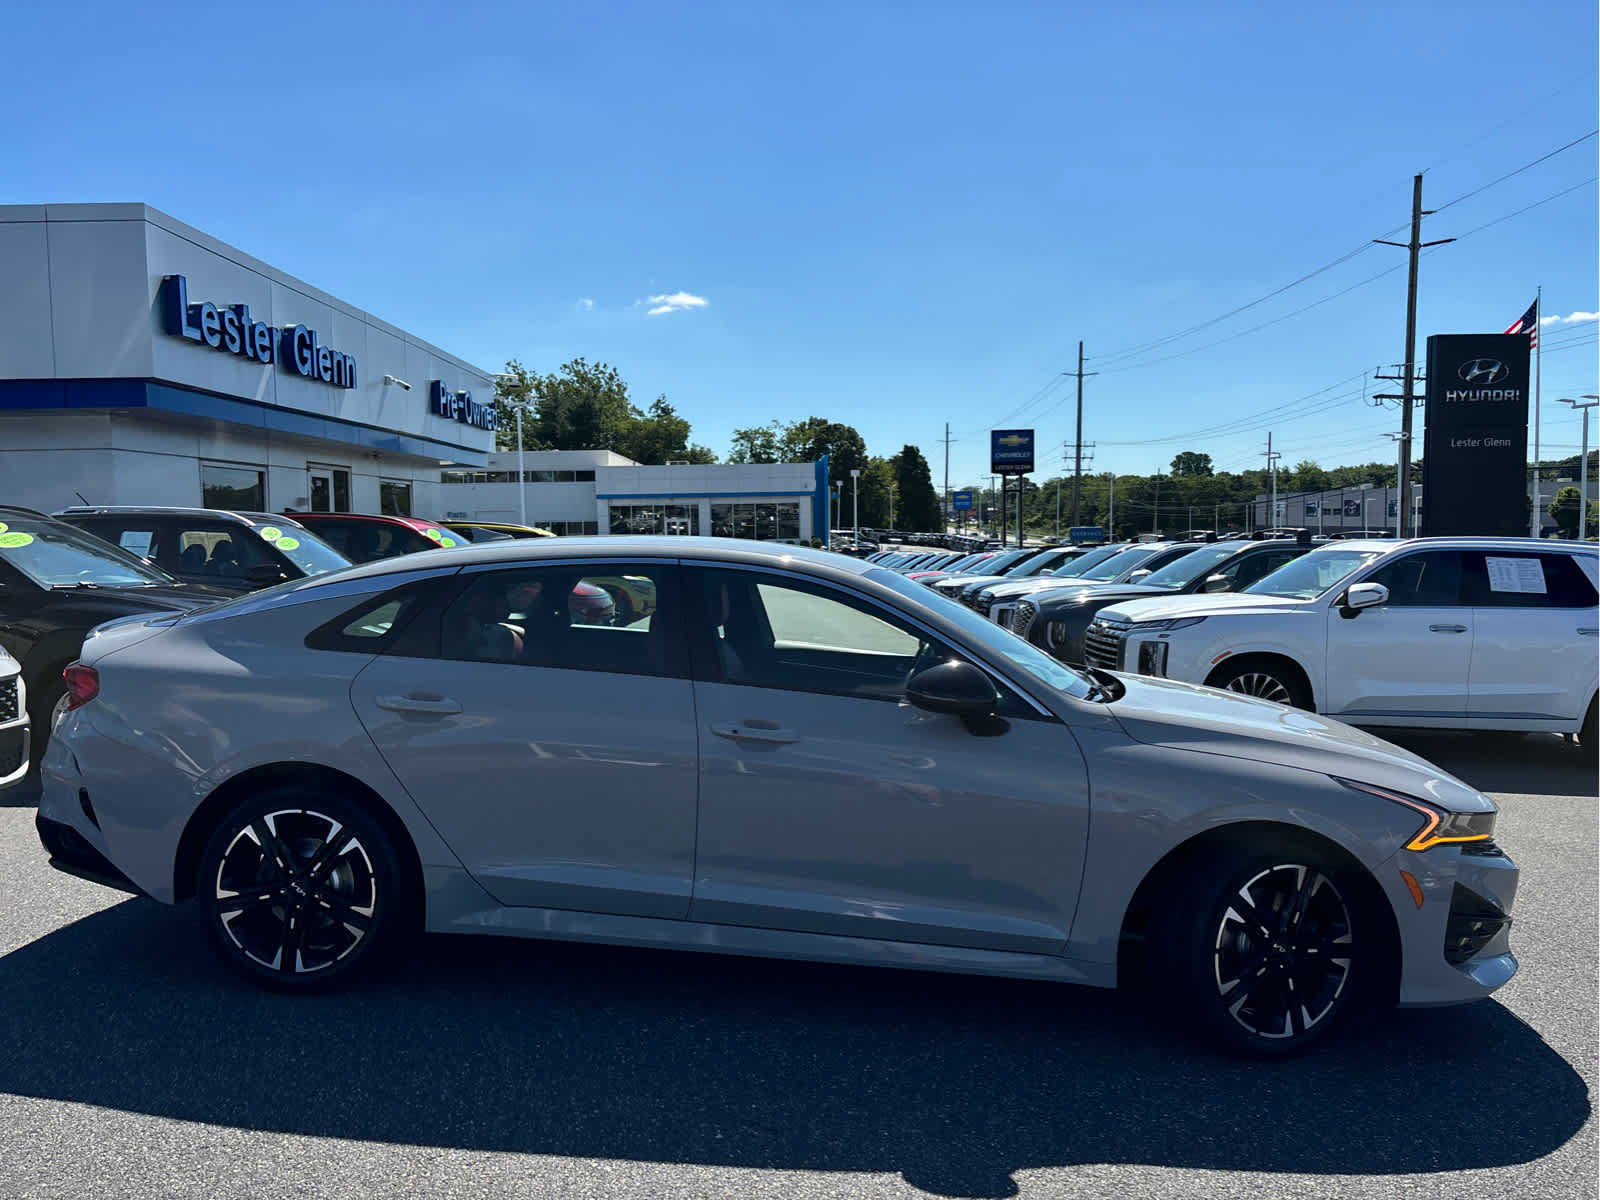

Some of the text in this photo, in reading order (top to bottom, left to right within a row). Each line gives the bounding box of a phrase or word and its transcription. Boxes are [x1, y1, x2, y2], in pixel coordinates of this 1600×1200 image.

[162, 274, 357, 389] Lester Glenn
[1446, 389, 1520, 402] HYUNDAI
[1451, 437, 1511, 447] Lester Glenn
